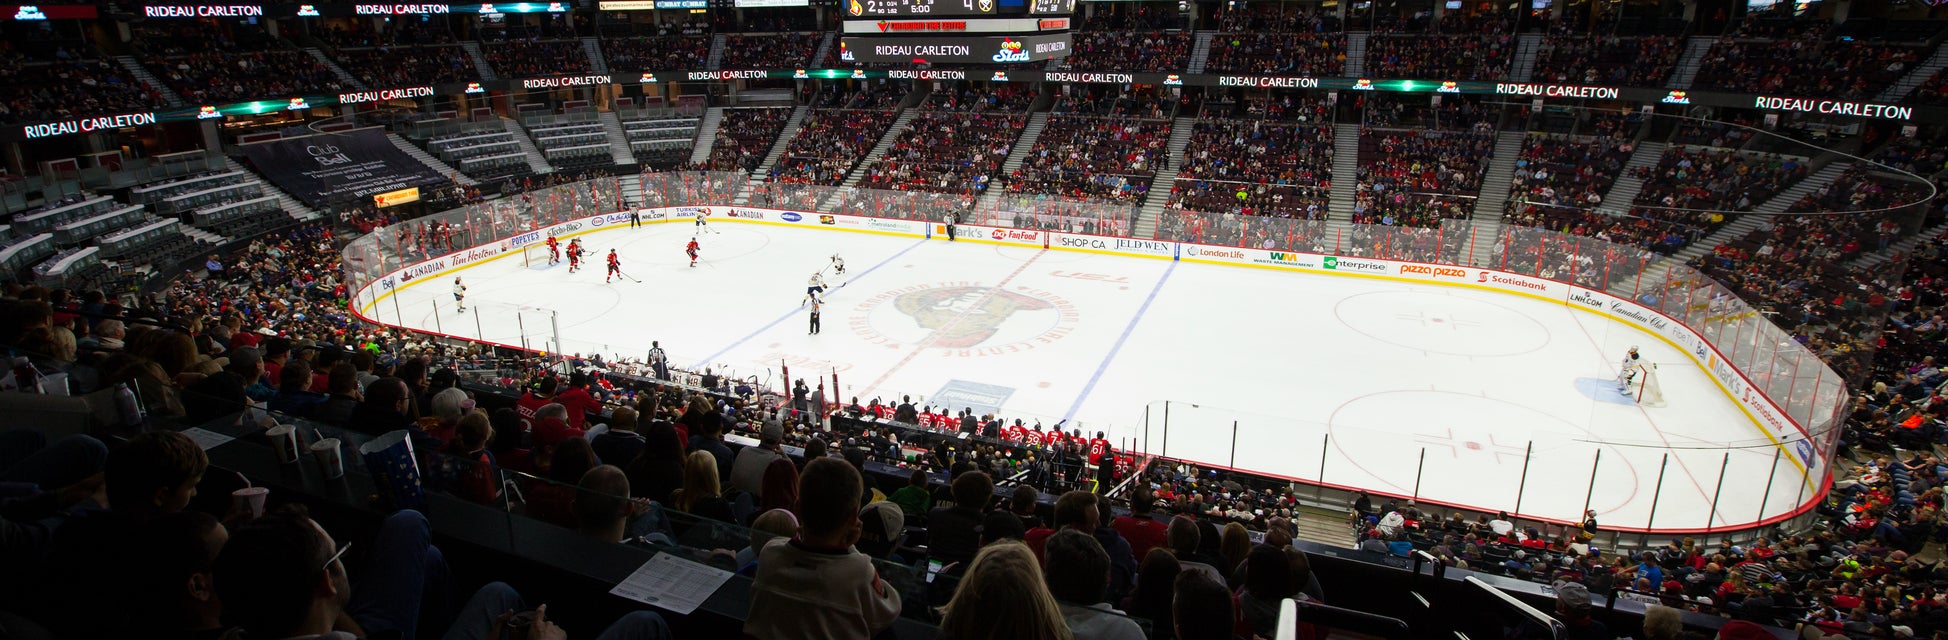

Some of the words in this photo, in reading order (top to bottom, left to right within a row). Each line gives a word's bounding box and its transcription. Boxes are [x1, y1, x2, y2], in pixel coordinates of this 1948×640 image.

[145, 5, 194, 17] RIDEAU
[198, 5, 262, 17] CARLETON
[356, 5, 392, 15] RIDEAU
[395, 4, 449, 14] CARLETON
[867, 1, 876, 12] 2
[876, 45, 913, 56] RIDEAU
[914, 45, 969, 56] CARLETON
[992, 49, 1030, 62] Slots
[688, 71, 720, 81] RIDEAU
[721, 70, 767, 80] CARLETON
[888, 70, 919, 80] RIDEAU
[920, 70, 965, 80] CARLETON
[1045, 72, 1079, 82] RIDEAU
[1081, 73, 1132, 83] CARLETON
[524, 78, 559, 89] RIDEAU
[561, 75, 611, 87] CARLETON
[1219, 76, 1257, 87] RIDEAU
[1260, 77, 1318, 88] CARLETON
[339, 91, 378, 104] RIDEAU
[381, 86, 434, 100] CARLETON
[1496, 83, 1543, 96] RIDEAU
[1546, 84, 1619, 99] CARLETON
[1755, 97, 1814, 113] RIDEAU
[1818, 100, 1912, 120] CARLETON
[24, 120, 79, 139] RIDEAU
[81, 112, 155, 131] CARLETON
[306, 144, 339, 157] Club
[314, 152, 352, 166] Bell
[737, 209, 763, 219] CANADIAN
[511, 231, 539, 246] POPEYE'S
[451, 253, 466, 266] Tim
[1200, 248, 1229, 259] London
[1230, 250, 1244, 259] Life
[410, 260, 445, 279] CANADIAN
[1400, 264, 1431, 275] pizza
[1433, 266, 1466, 277] pizza
[1491, 275, 1546, 292] Scotiabank
[1570, 293, 1602, 308] LNH.COM
[1610, 300, 1648, 323] Canadian
[1713, 359, 1741, 394] Mark's
[1750, 396, 1784, 432] Scotiabank
[1026, 433, 1040, 445] 59
[1092, 444, 1102, 455] 61
